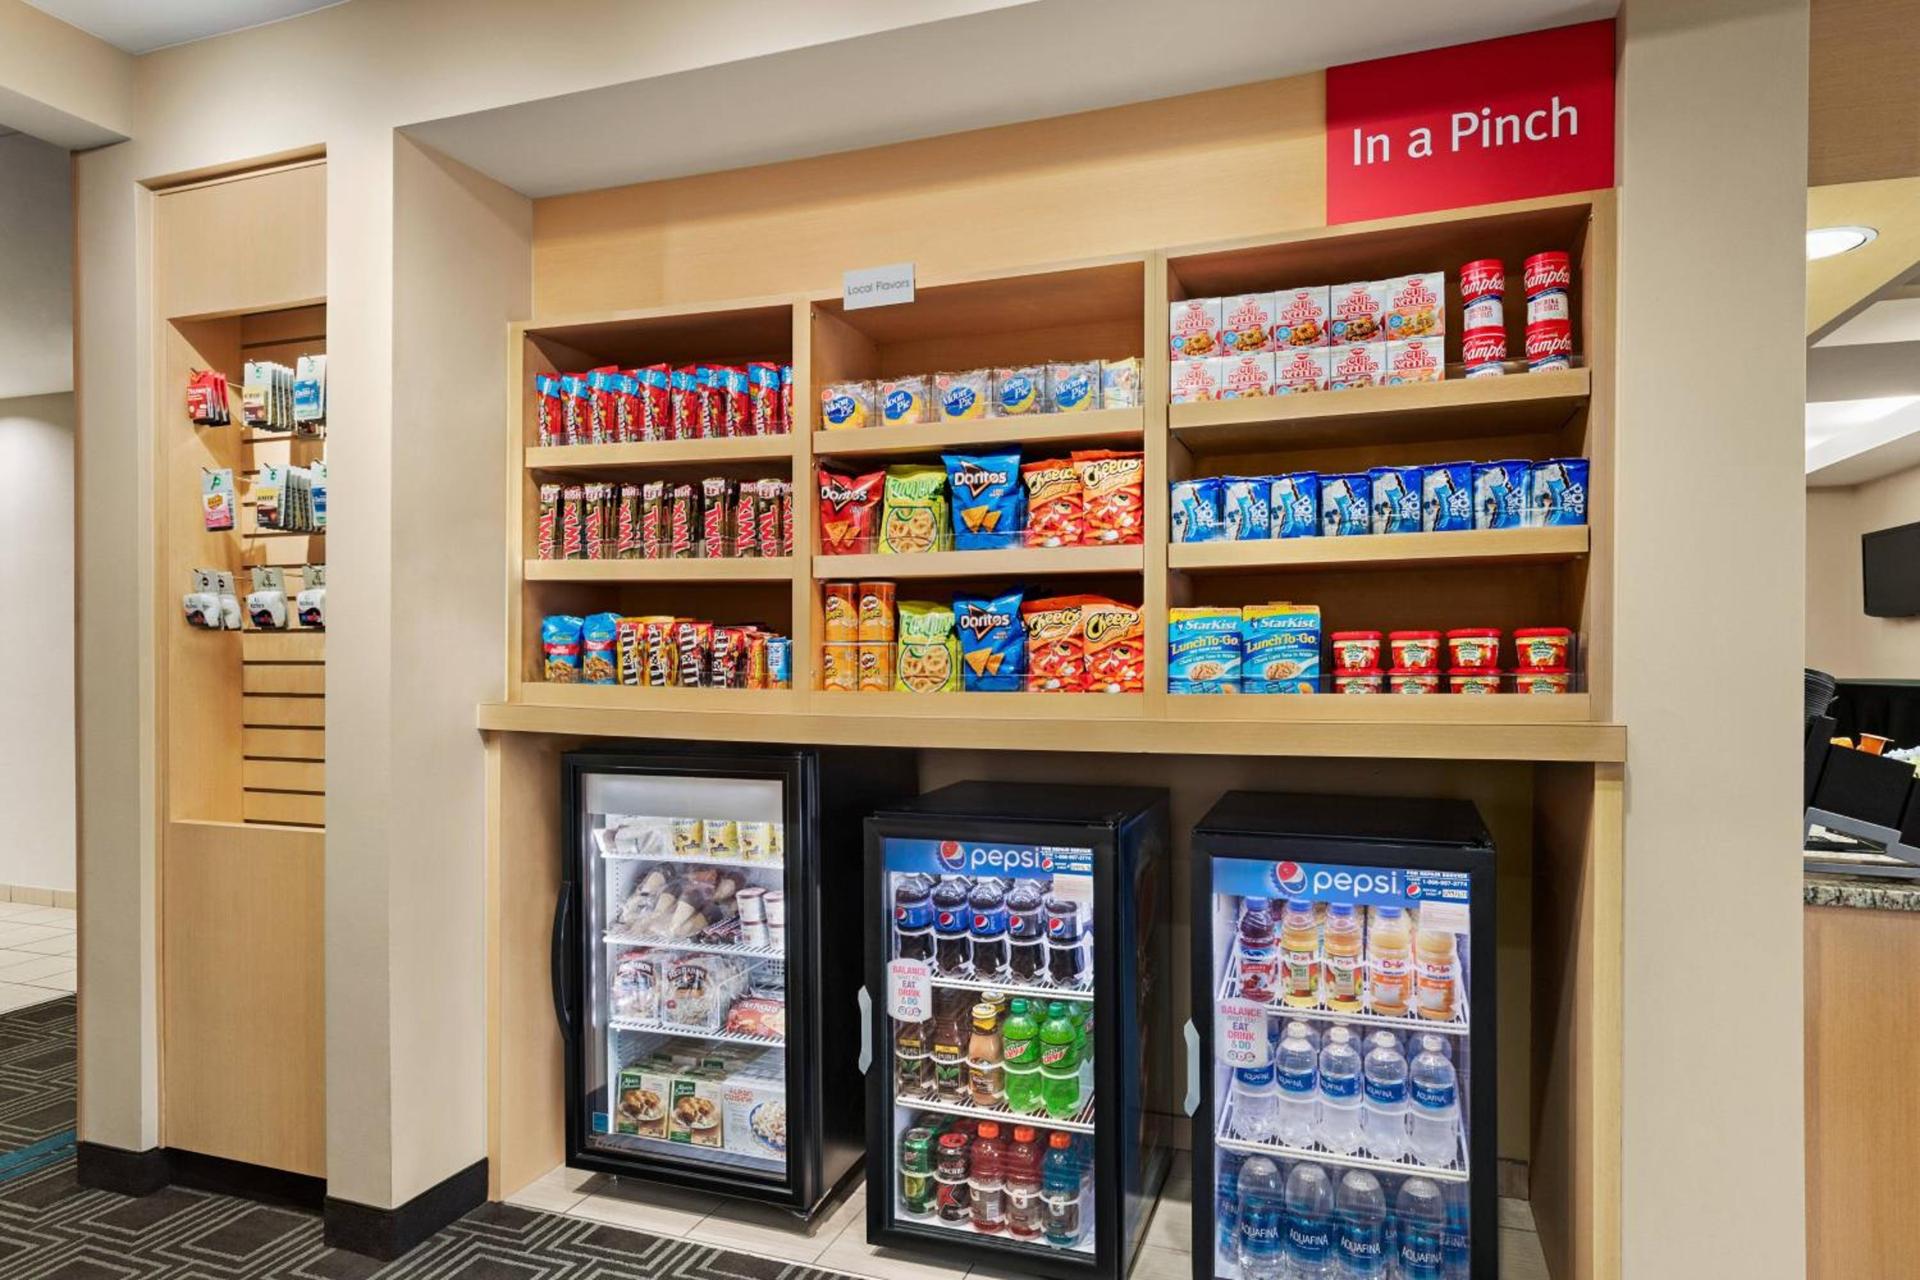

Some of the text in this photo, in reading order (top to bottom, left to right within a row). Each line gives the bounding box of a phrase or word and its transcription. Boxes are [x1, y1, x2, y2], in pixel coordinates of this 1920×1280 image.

[1353, 96, 1578, 166] In a Pinch
[847, 279, 910, 297] Local Flavors
[954, 470, 1007, 486] Doritos
[1082, 458, 1142, 489] Cheetos
[821, 486, 868, 501] Doritos
[705, 502, 722, 559] TWIX
[736, 496, 757, 557] TWIX
[960, 613, 1011, 629] Doritos
[1184, 619, 1238, 631] StarKist
[1260, 617, 1316, 628] StarKist
[970, 847, 1040, 871] pepsi
[1313, 871, 1398, 898] pepsi
[892, 965, 928, 976] BALANCE
[902, 980, 917, 988] EAT
[898, 988, 920, 997] DRINK
[1221, 1005, 1262, 1017] BALANCE
[1233, 1021, 1249, 1031] EAT
[1228, 1030, 1255, 1041] DRINK
[1238, 1040, 1251, 1050] DO
[1241, 1222, 1279, 1239] AQUAFINA
[1289, 1228, 1329, 1246] AQUAFINA
[1341, 1235, 1381, 1254] AQUAFINA
[1401, 1245, 1442, 1263] AQUAFINA
